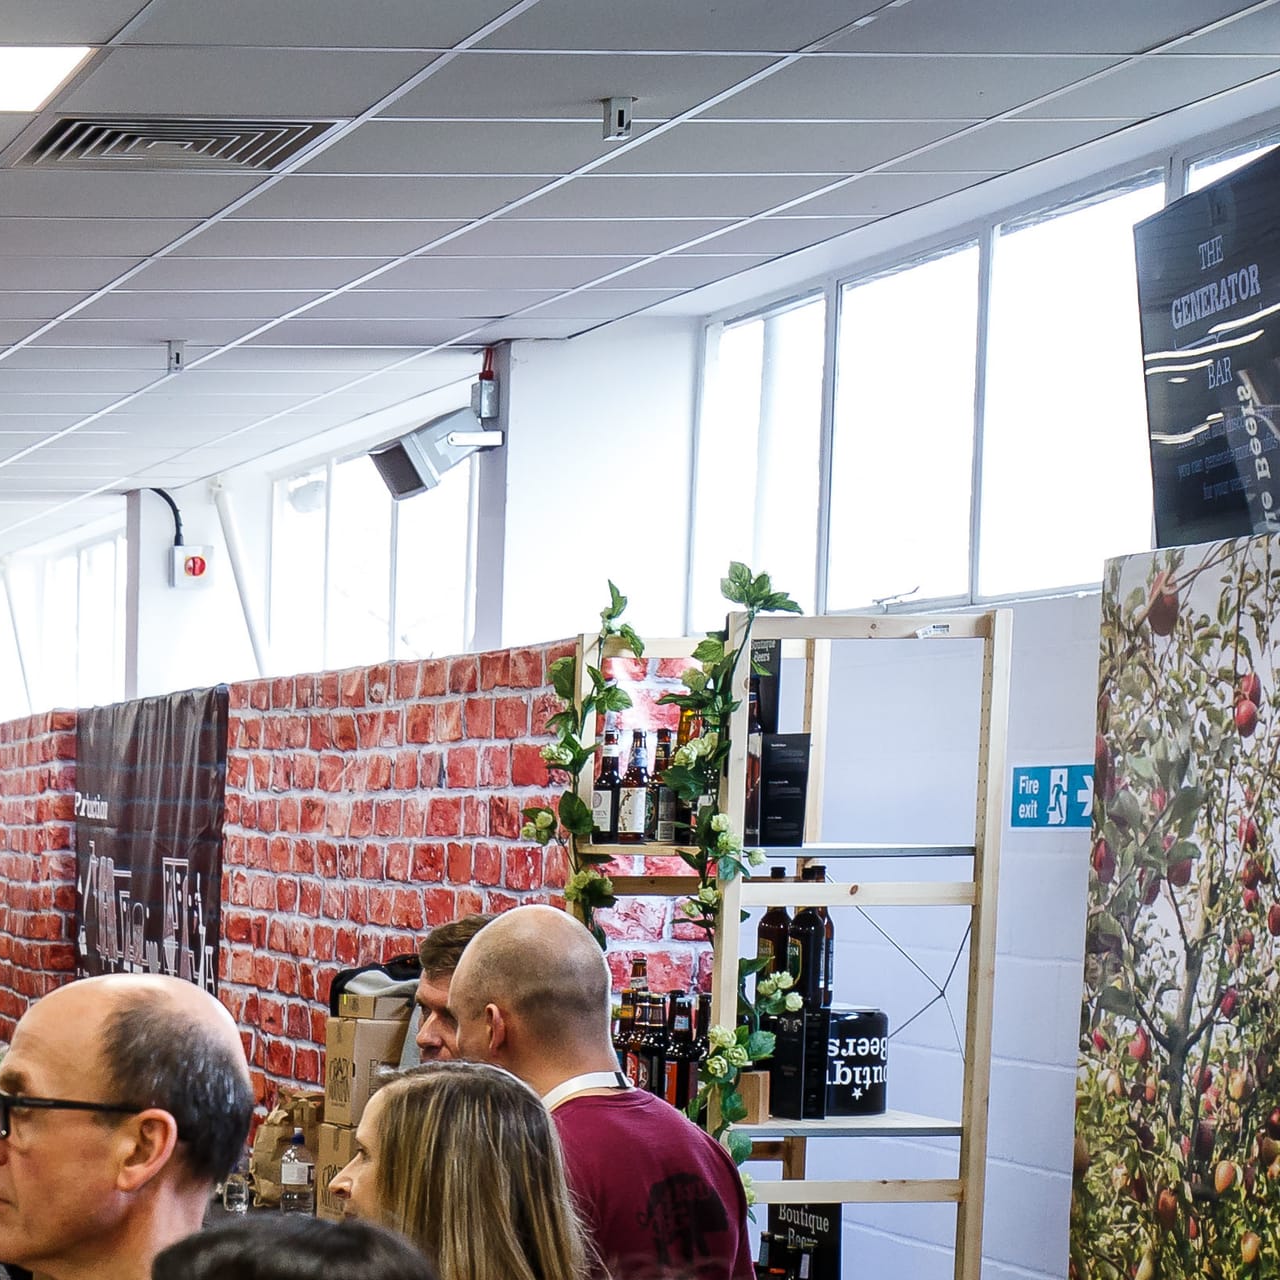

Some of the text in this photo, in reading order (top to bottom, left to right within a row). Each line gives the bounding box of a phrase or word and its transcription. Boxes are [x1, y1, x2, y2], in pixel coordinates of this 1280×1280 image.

[1198, 235, 1224, 270] THE
[1172, 263, 1261, 330] GENERATOR
[1208, 356, 1233, 390] BAR
[1019, 775, 1040, 795] Fire
[1019, 799, 1038, 819] exit
[778, 1204, 829, 1235] Boutique
